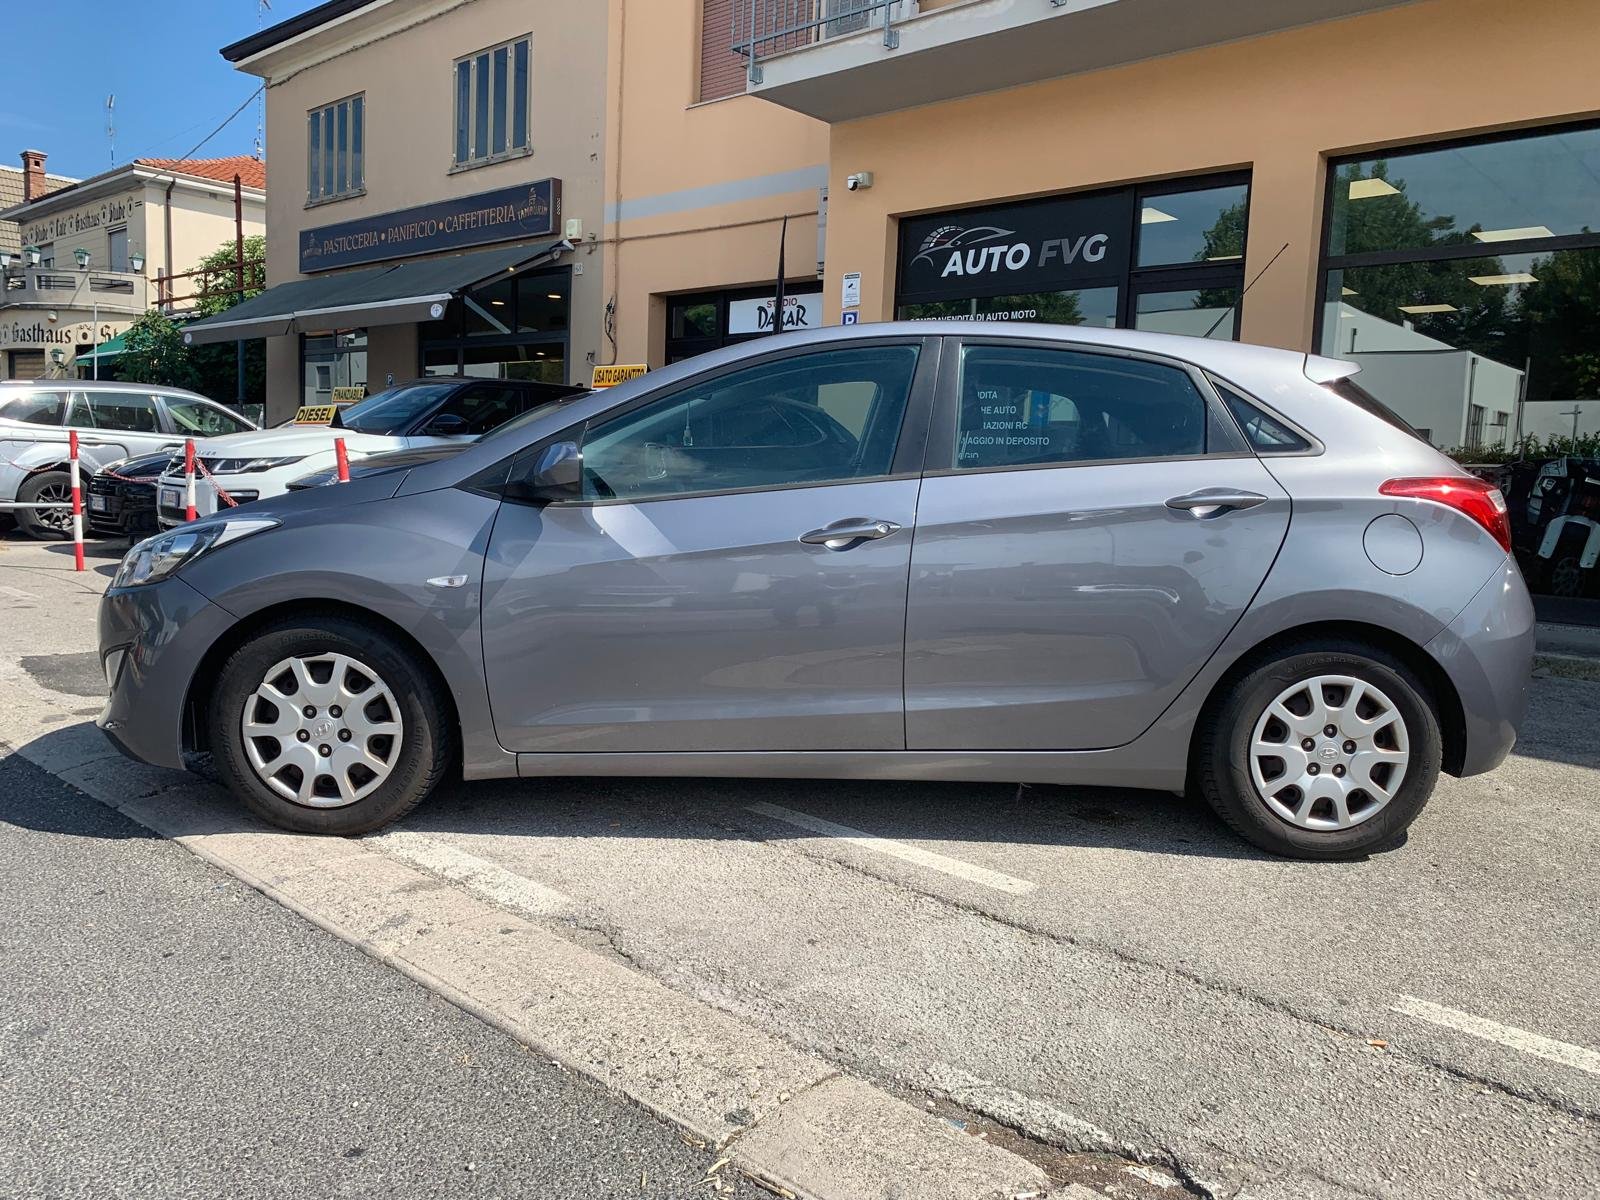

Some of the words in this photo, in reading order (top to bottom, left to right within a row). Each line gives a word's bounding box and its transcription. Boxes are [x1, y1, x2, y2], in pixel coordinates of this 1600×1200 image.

[323, 230, 379, 255] PASTICCERIA
[387, 219, 437, 244] PANIFICIO
[444, 204, 516, 233] CAFFETTERIA
[941, 243, 1031, 278] AUTO
[1037, 233, 1109, 268] FVG
[976, 313, 985, 322] DI
[986, 311, 1010, 322] AUTO
[1010, 309, 1037, 319] MOTO
[12, 321, 72, 344] Gasthaus
[594, 368, 613, 384] USATO
[296, 407, 332, 421] DIESEL
[993, 405, 1017, 414] AUTO
[1015, 421, 1028, 430] RC
[995, 436, 1005, 445] IN
[1006, 436, 1050, 446] DEPOSITO
